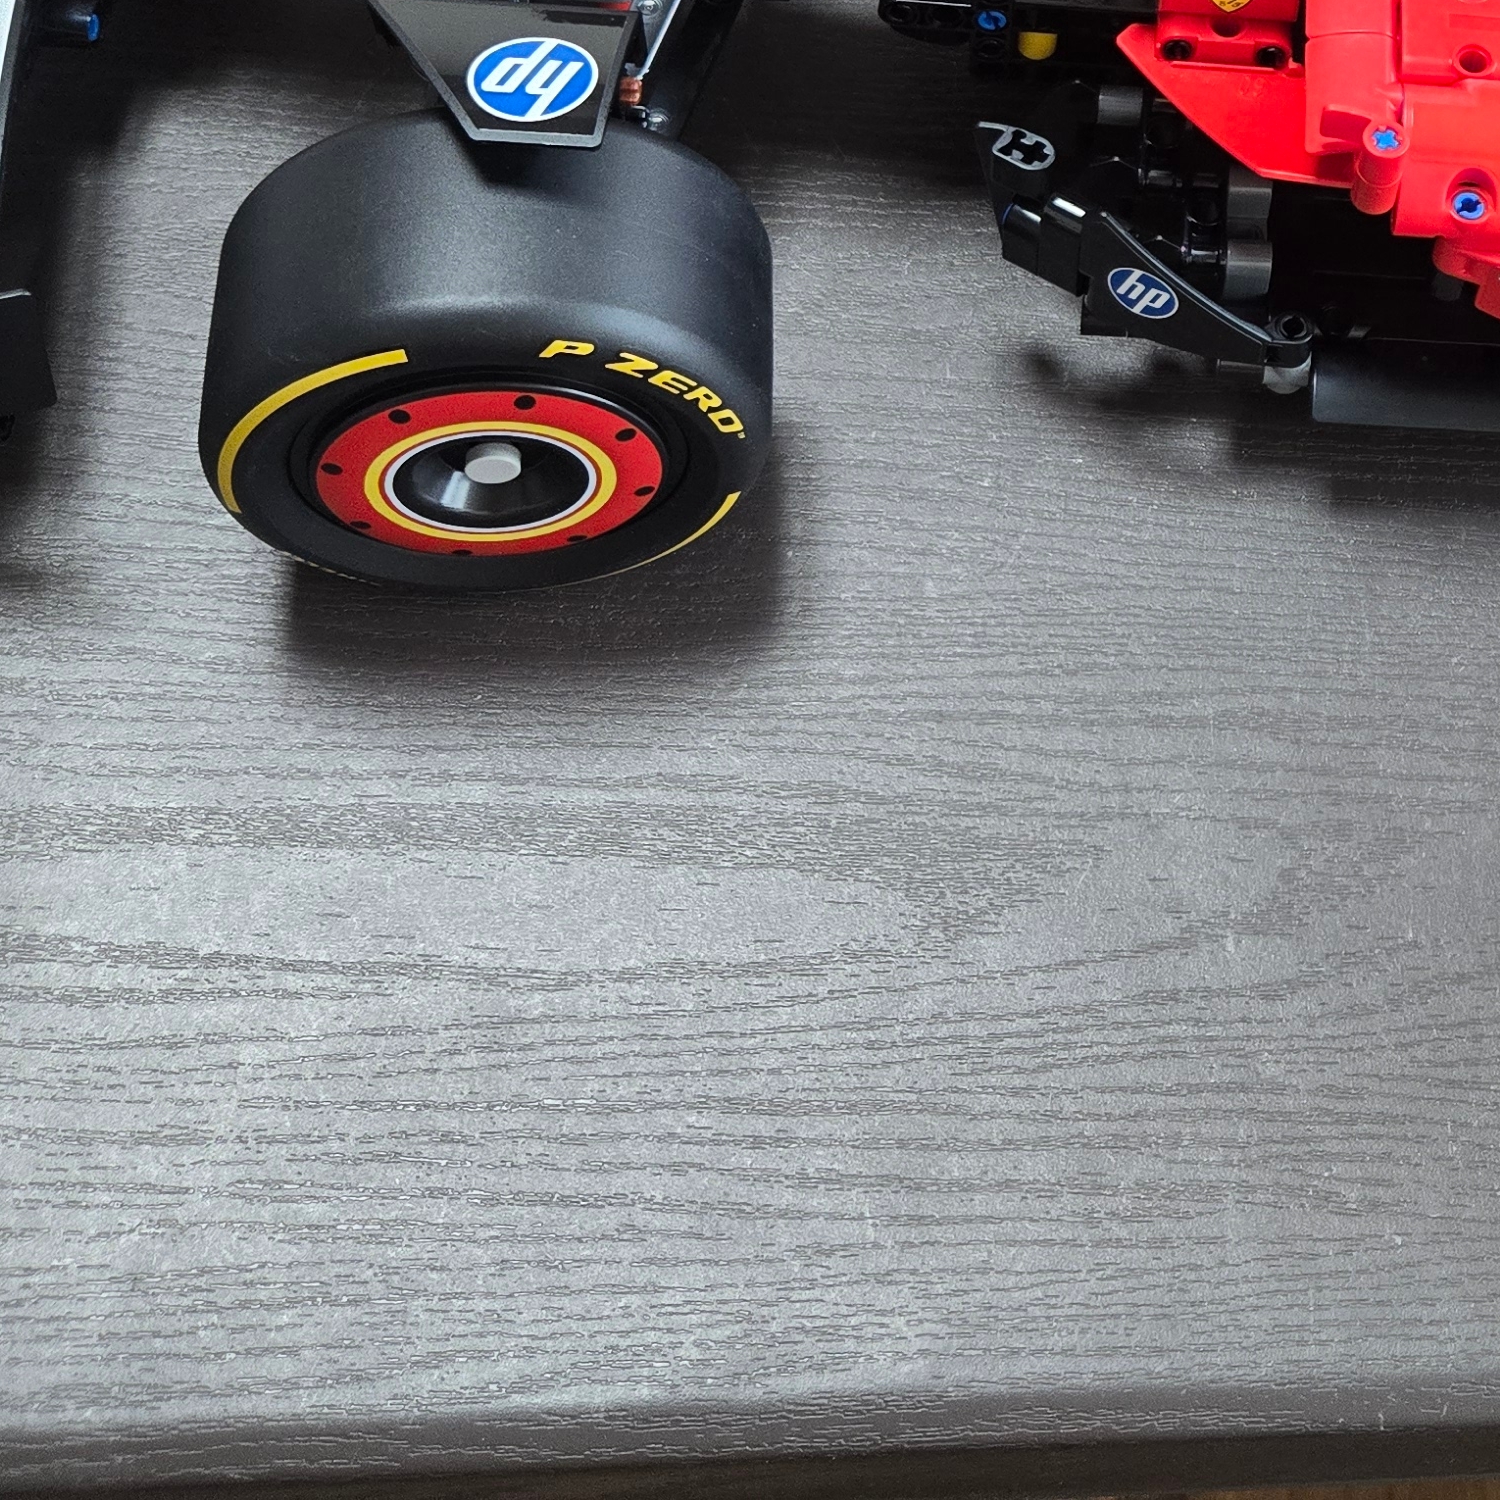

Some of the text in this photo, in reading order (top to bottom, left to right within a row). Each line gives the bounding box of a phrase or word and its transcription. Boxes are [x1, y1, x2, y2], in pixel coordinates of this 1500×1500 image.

[481, 40, 585, 117] hp
[1116, 269, 1171, 313] hp
[538, 339, 744, 434] P ZERO
